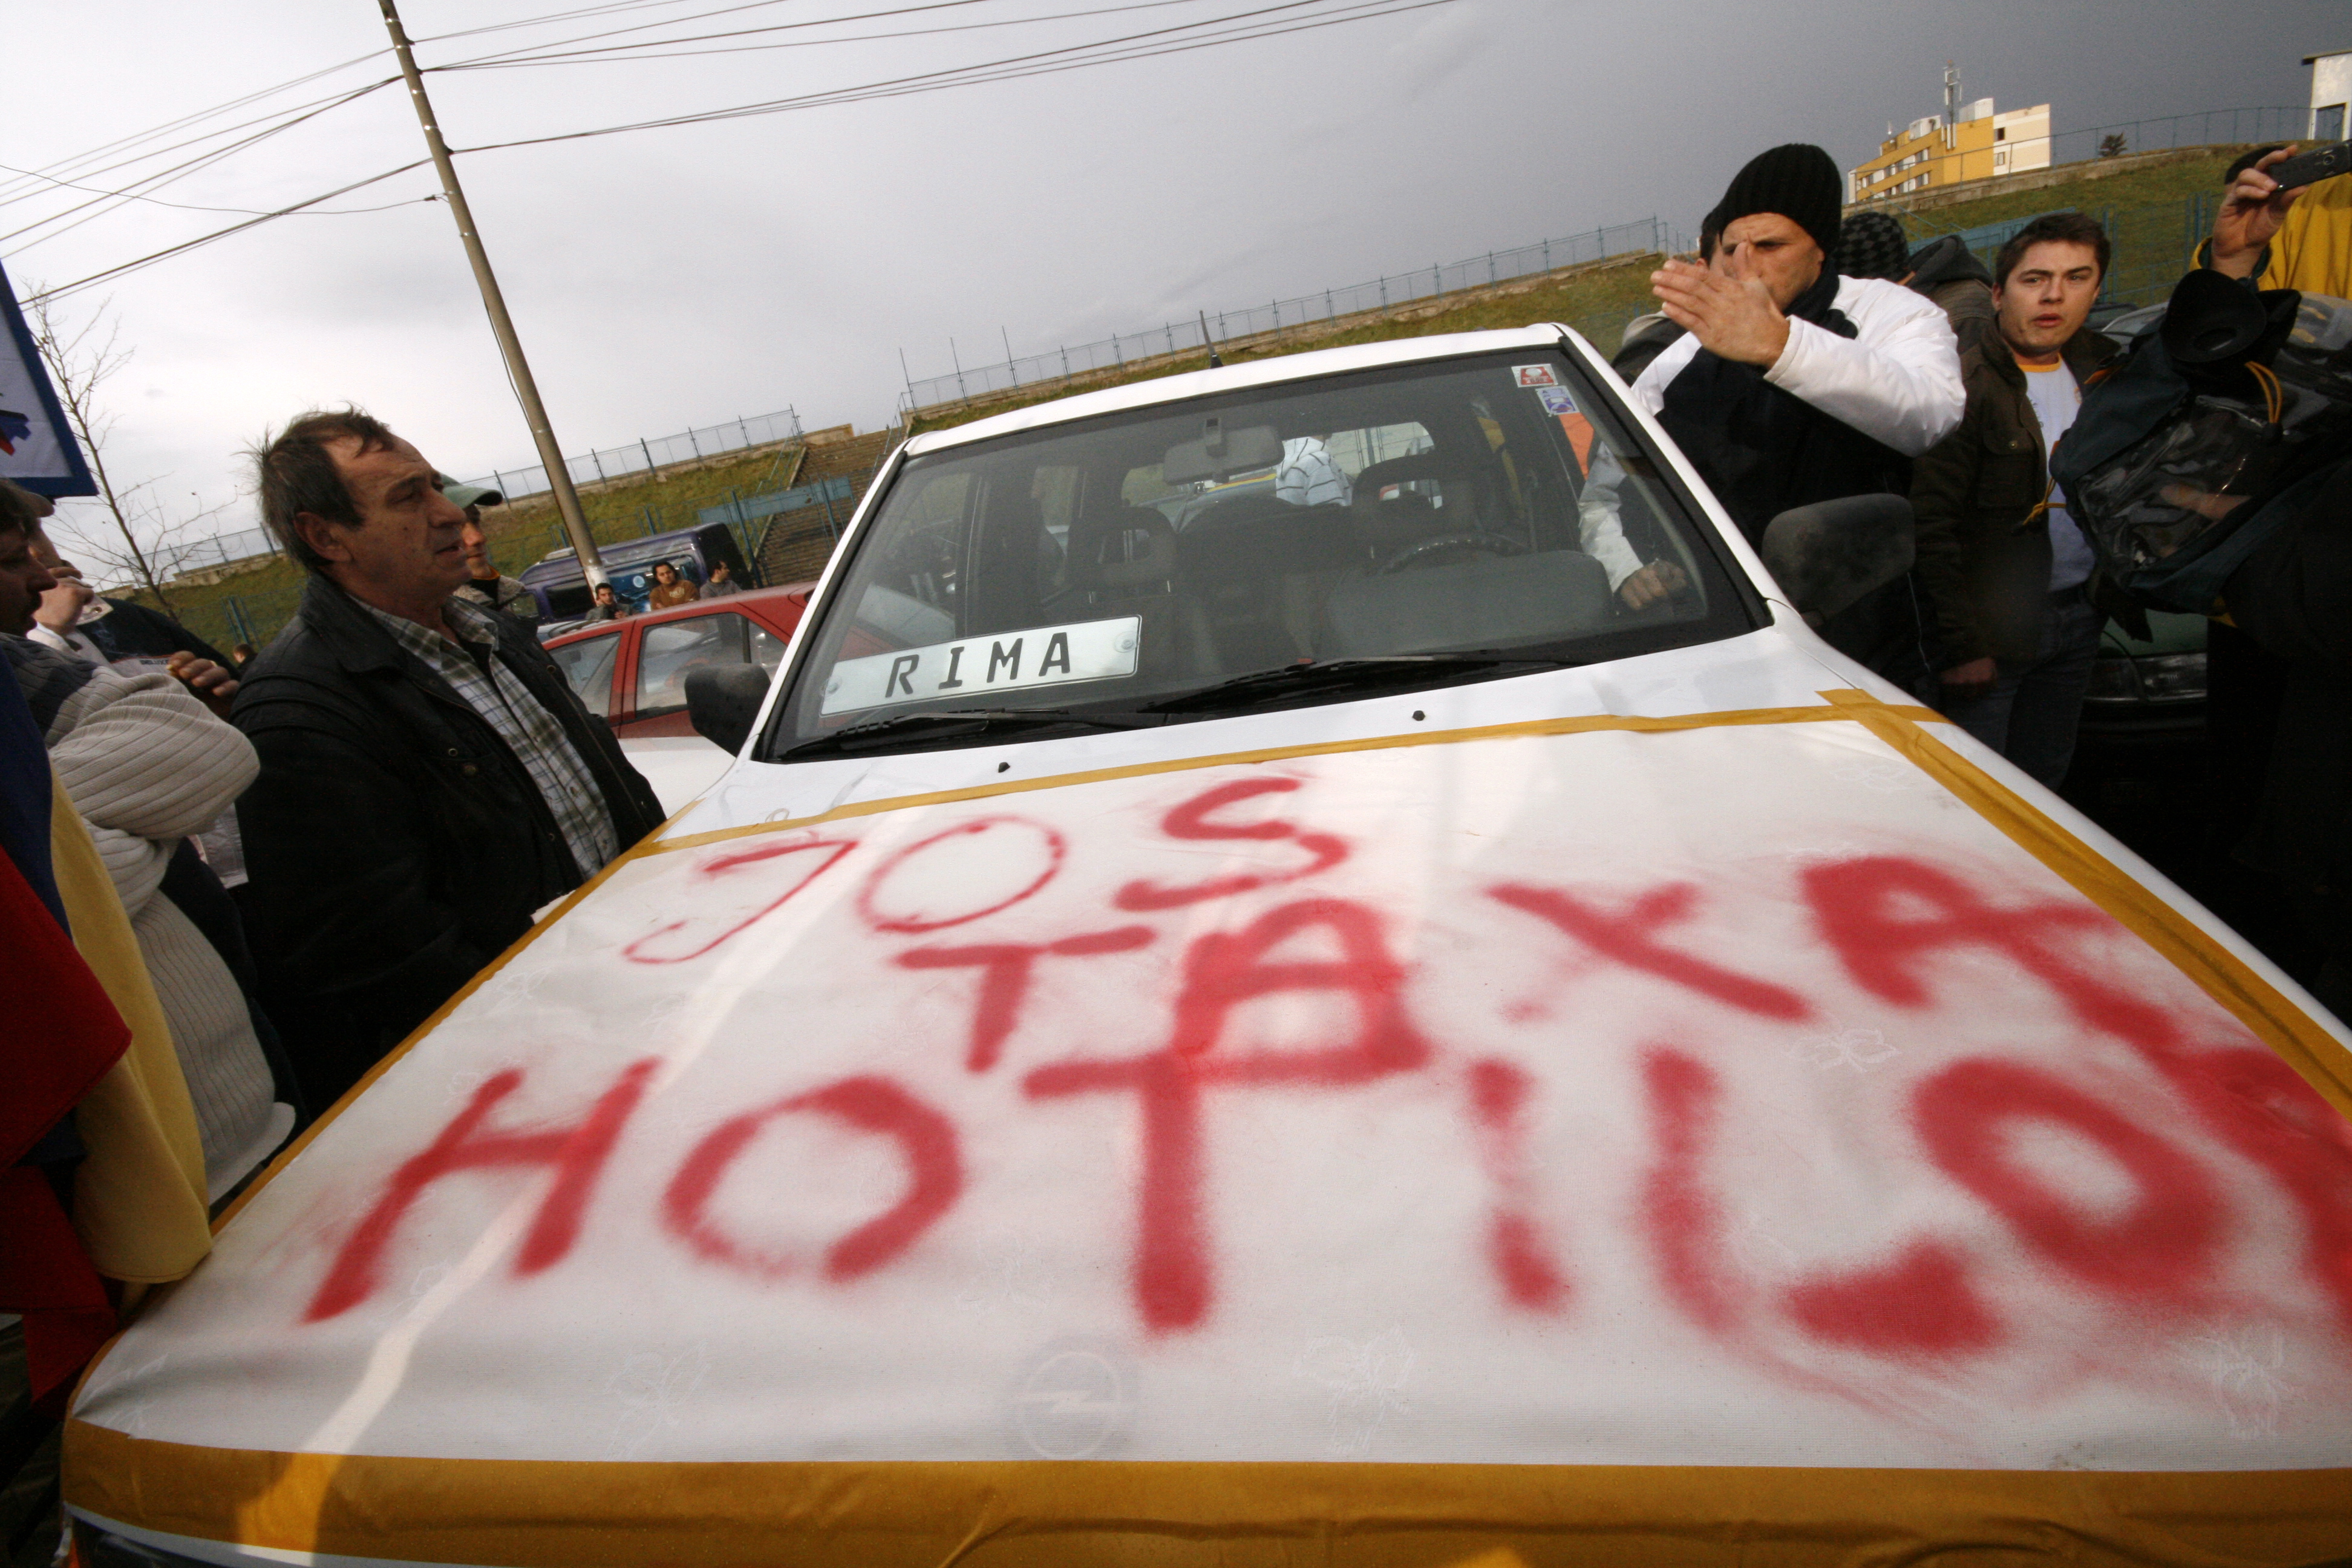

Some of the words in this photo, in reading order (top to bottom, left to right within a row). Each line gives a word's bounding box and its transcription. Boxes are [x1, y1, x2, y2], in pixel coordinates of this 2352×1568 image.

[885, 632, 1071, 698] RIMA
[623, 776, 1352, 965] JOS
[892, 856, 2181, 1080] TAXA
